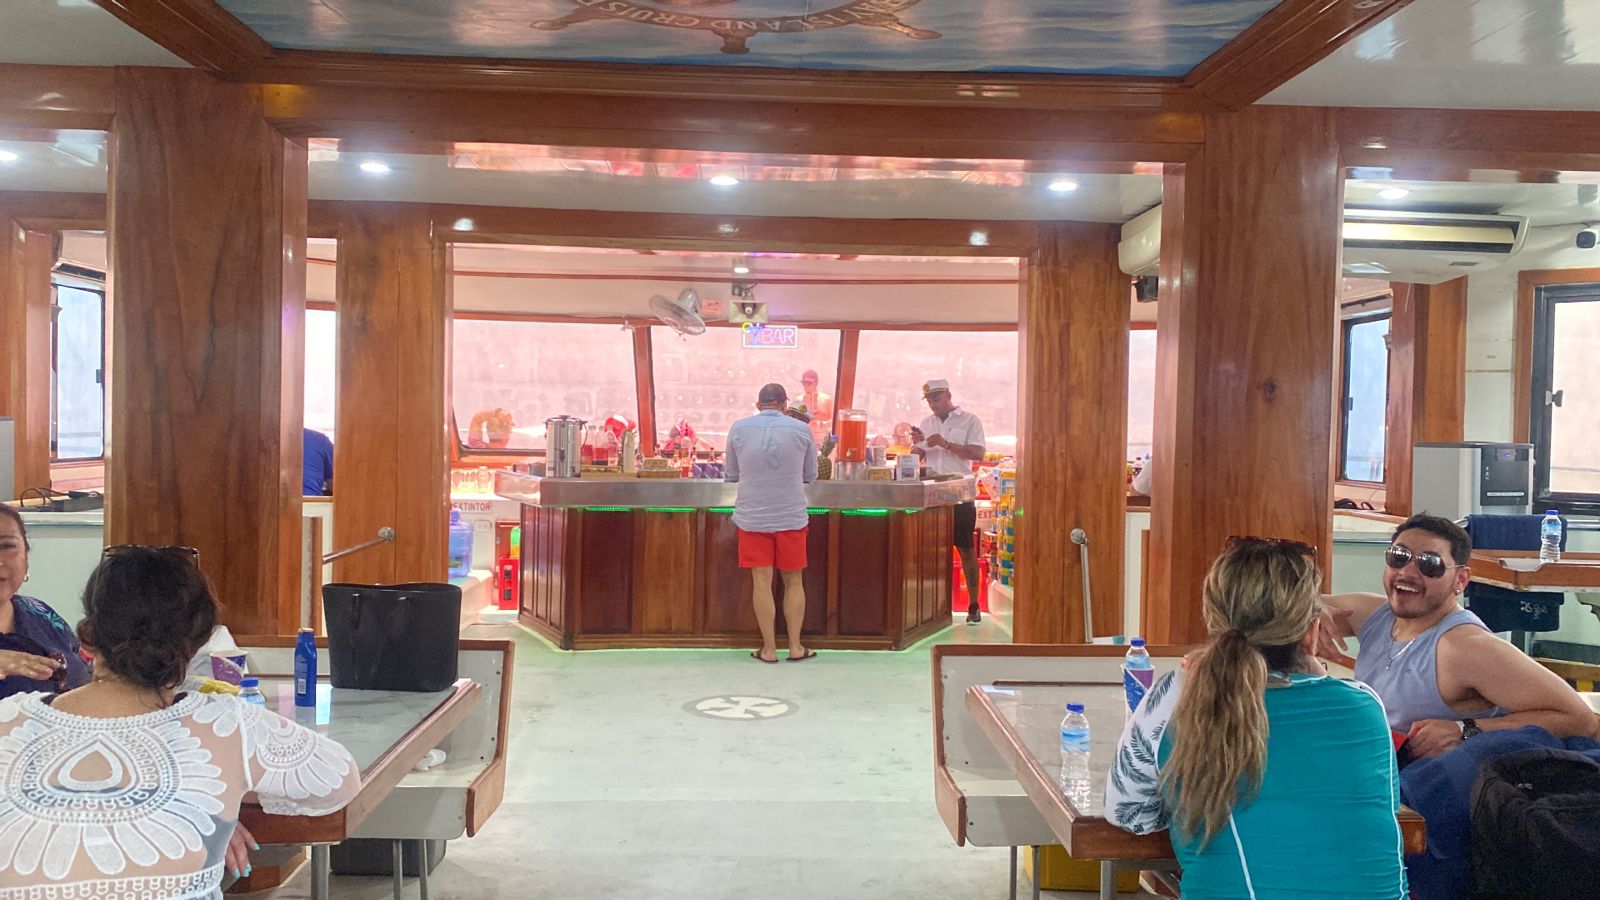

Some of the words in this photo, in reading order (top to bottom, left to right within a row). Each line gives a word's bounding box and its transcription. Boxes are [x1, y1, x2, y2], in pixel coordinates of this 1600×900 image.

[710, 13, 846, 31] ISLAND
[762, 328, 794, 344] BAR
[453, 502, 491, 511] EXTINTOR
